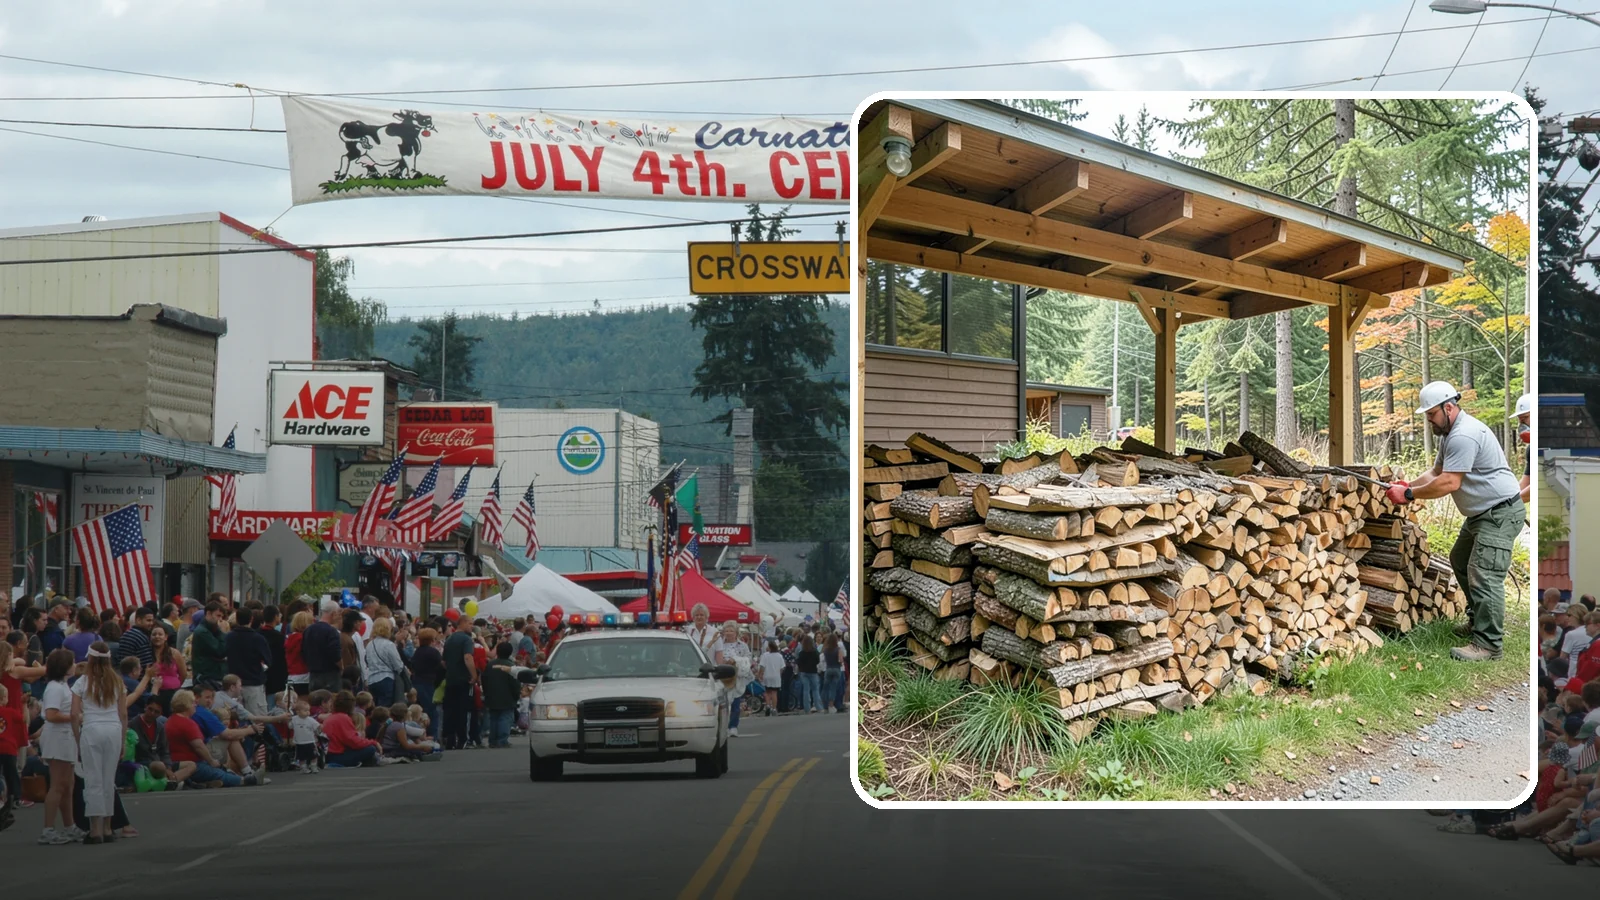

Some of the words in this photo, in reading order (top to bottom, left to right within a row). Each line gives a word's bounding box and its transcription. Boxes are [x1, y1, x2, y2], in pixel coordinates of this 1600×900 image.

[481, 141, 605, 192] JULY
[632, 149, 746, 198] 4th.
[697, 254, 850, 280] CROSSWA
[282, 380, 373, 420] ACE
[283, 421, 371, 436] Hardware
[416, 428, 477, 447] Coca-Cola
[96, 485, 124, 495] Vincent
[126, 485, 136, 495] de
[138, 486, 155, 495] Paul
[81, 503, 154, 522] THT
[212, 516, 331, 536] HARDARE
[688, 526, 741, 535] CRNATION
[699, 535, 730, 543] GLASS
